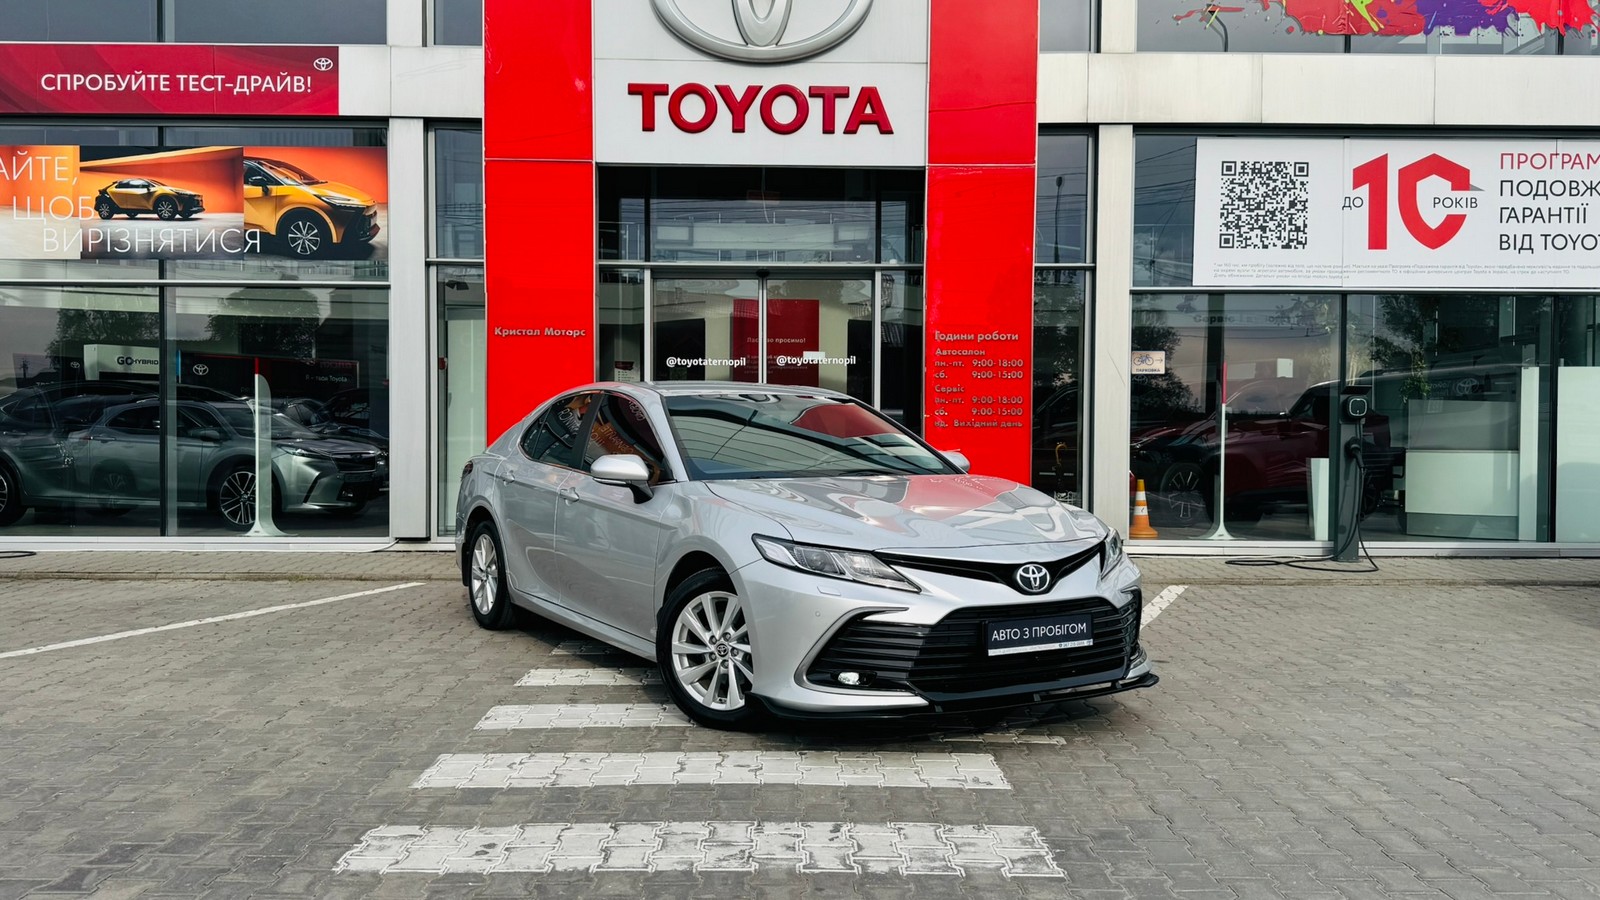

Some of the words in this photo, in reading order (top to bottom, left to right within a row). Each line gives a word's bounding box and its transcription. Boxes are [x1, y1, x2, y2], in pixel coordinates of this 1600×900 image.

[41, 71, 170, 92] СПРОБУЙТЕ
[178, 72, 312, 95] ТЕСТ-ДРАЙВ!
[628, 82, 894, 135] TOYOTA
[1500, 153, 1600, 170] ПРОГРАМ
[1500, 180, 1600, 200] ПОДОВЖ
[1342, 196, 1364, 210] ДО
[1433, 197, 1478, 209] РОКІВ
[13, 196, 95, 225] ЩОБ
[1500, 203, 1589, 224] ГАРАНТІЇ
[43, 228, 261, 254] ВИРІЗНЯТИСЯ
[1499, 234, 1534, 254] ВІД
[1540, 234, 1600, 251] TOYO
[494, 327, 540, 337] Кристал
[544, 327, 586, 338] Моторс
[935, 330, 974, 341] Години
[977, 330, 1019, 342] роботи
[775, 337, 806, 345] просимо!
[666, 356, 746, 367] @toyotaternopil
[776, 355, 856, 366] @toyotaternopil
[935, 370, 948, 378] сб.
[935, 384, 965, 394] Сервіс
[934, 407, 948, 416] сб.
[954, 418, 998, 428] Вихідний
[991, 629, 1020, 642] АВТО
[1032, 622, 1087, 638] ПРОБІГОМ
